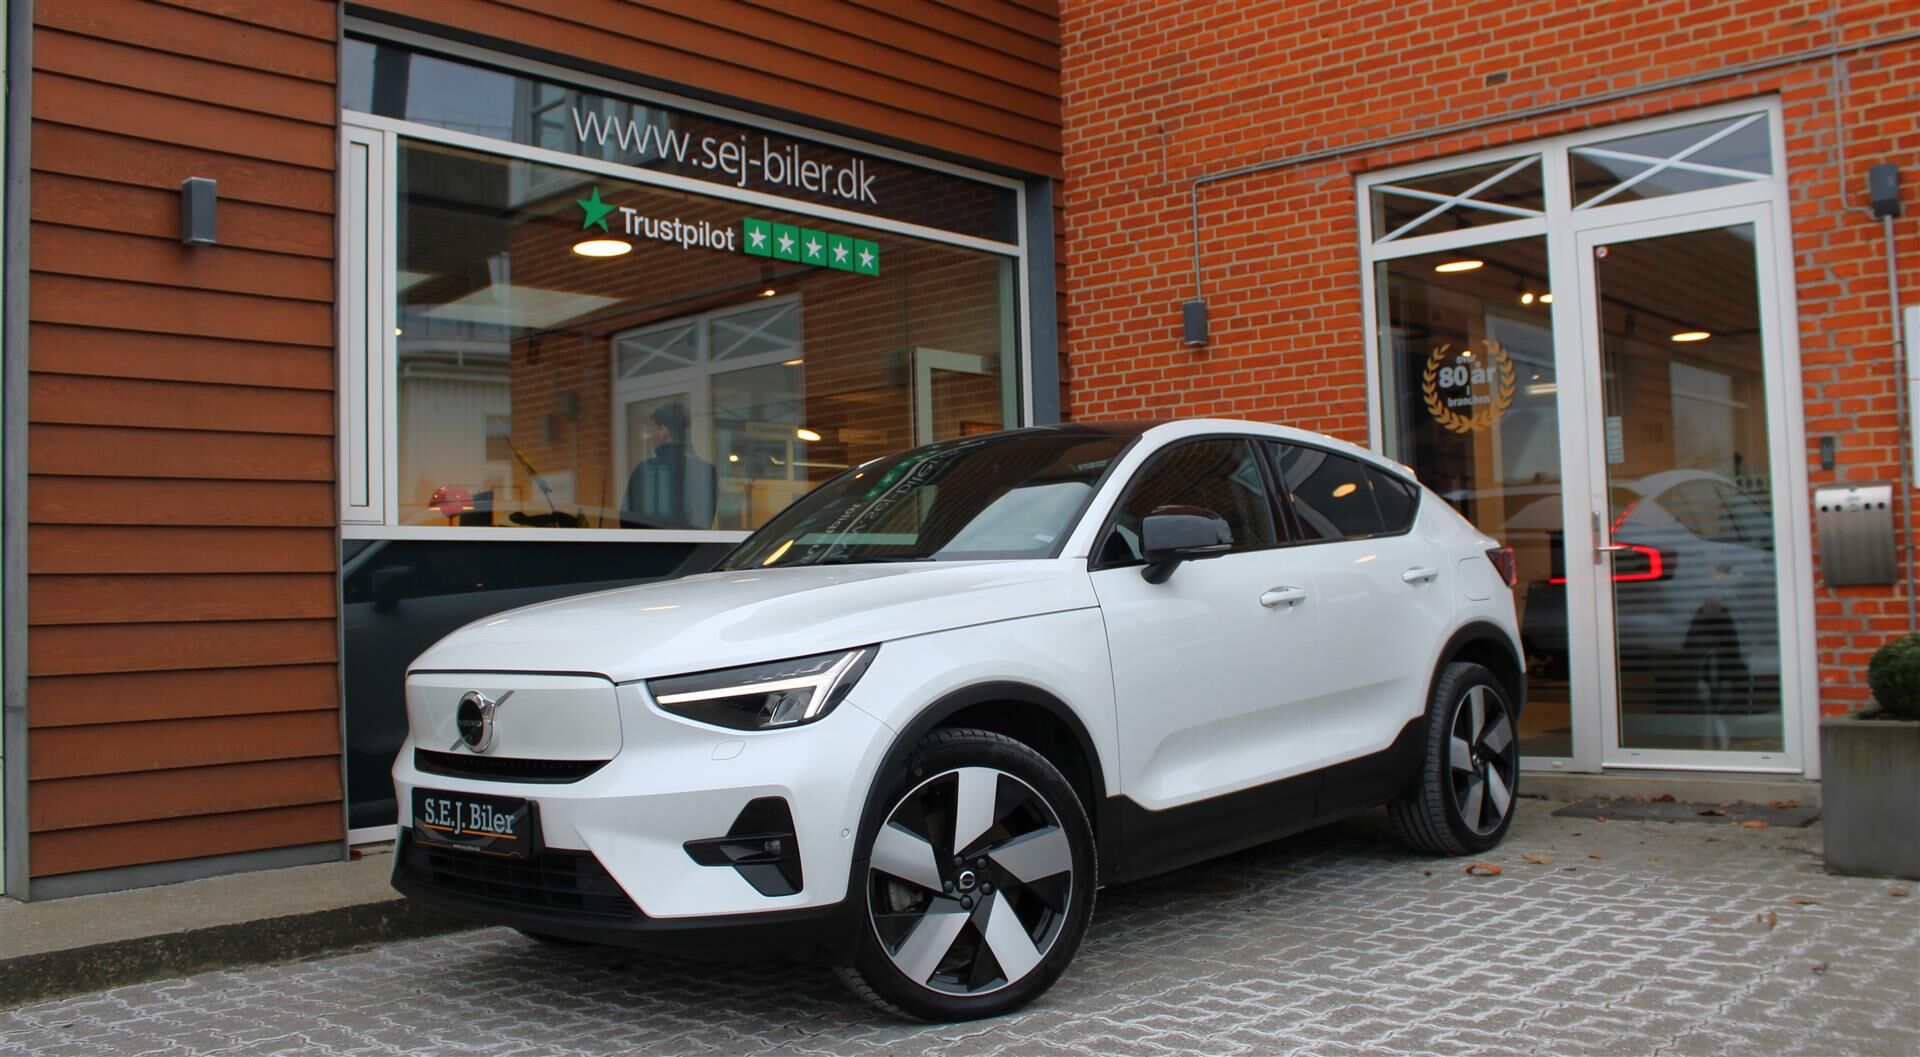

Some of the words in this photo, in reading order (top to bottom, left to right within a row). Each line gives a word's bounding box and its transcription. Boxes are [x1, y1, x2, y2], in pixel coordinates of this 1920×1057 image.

[572, 107, 878, 204] www.sej-biler.dk
[619, 207, 735, 251] Trustpilot
[1439, 365, 1468, 388] 80
[1471, 362, 1496, 384] år
[1448, 396, 1490, 407] branchen
[425, 799, 466, 834] S.E.J.
[470, 803, 514, 834] Biler
